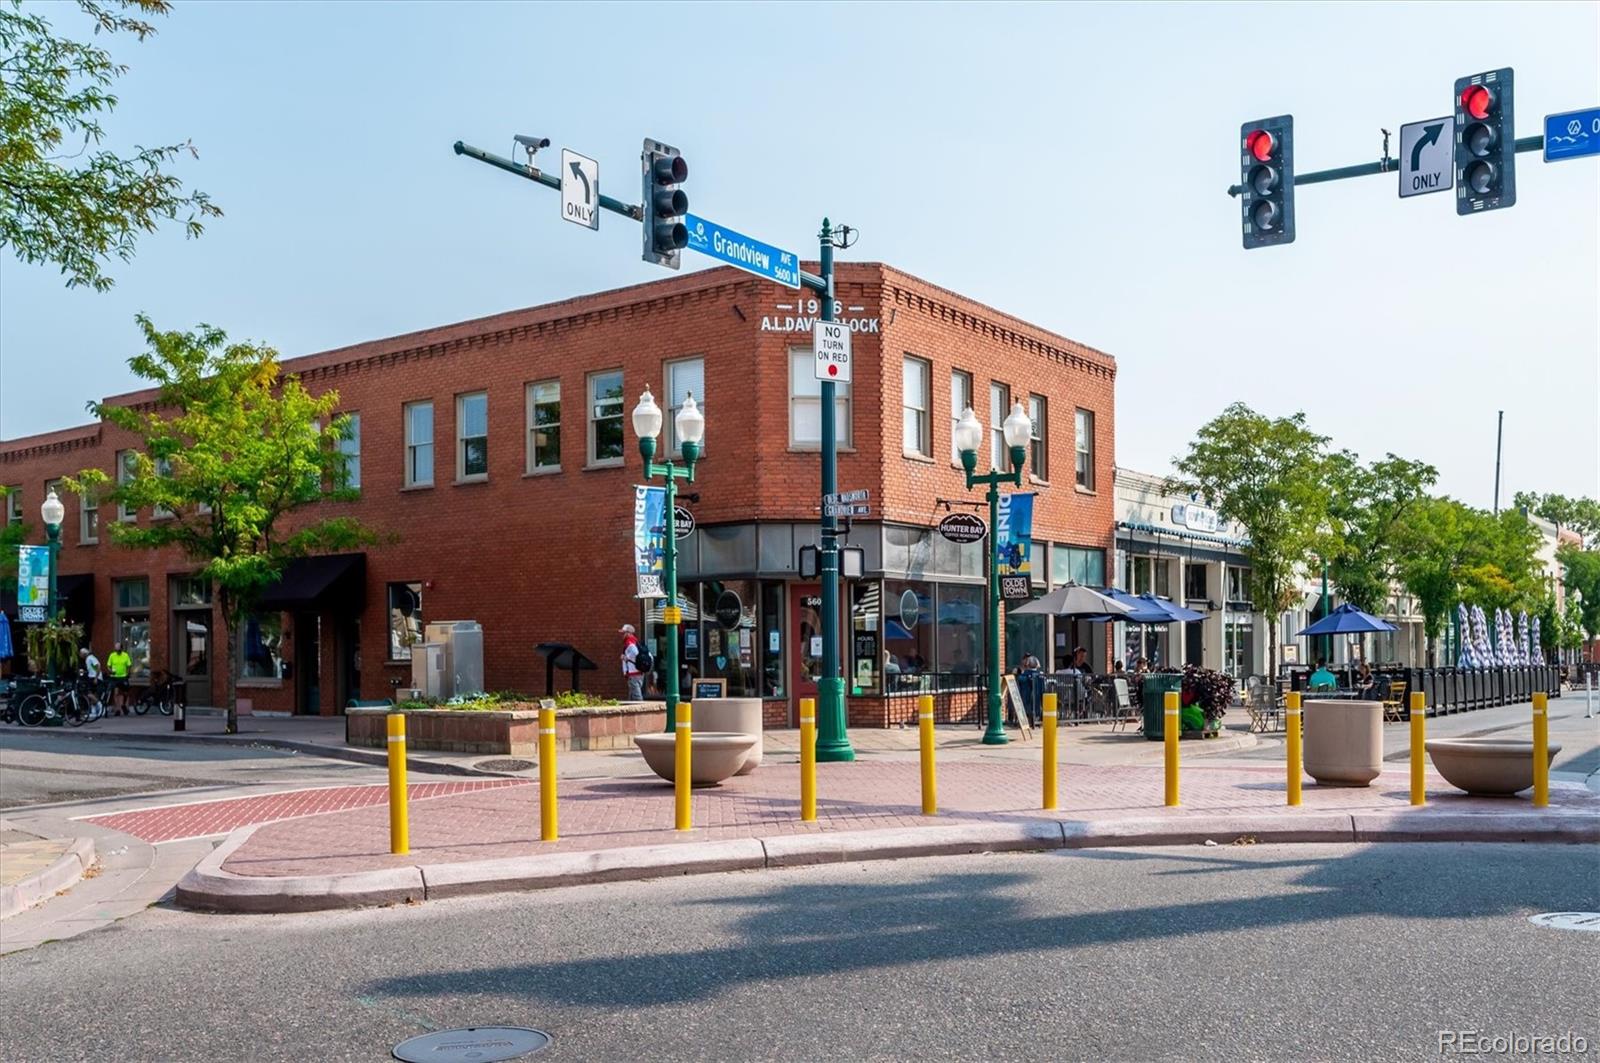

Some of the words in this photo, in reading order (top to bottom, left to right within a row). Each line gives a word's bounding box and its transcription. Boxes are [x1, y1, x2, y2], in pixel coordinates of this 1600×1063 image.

[1412, 172, 1441, 190] ONLY
[567, 202, 594, 222] ONLY
[713, 230, 770, 270] Grandview
[780, 252, 792, 267] AVE
[774, 266, 791, 282] 5600
[798, 299, 843, 315] 196
[761, 316, 822, 331] A.L.DAV
[825, 326, 841, 338] NO
[823, 339, 844, 350] TURN
[818, 351, 829, 361] ON
[832, 353, 848, 363] RED
[680, 519, 692, 528] BAY
[998, 494, 1012, 547] DINE
[941, 524, 969, 533] HUNTER
[970, 526, 984, 534] BAY
[1004, 578, 1024, 587] OLDE
[1005, 586, 1027, 594] TOWN
[807, 597, 822, 606] 560
